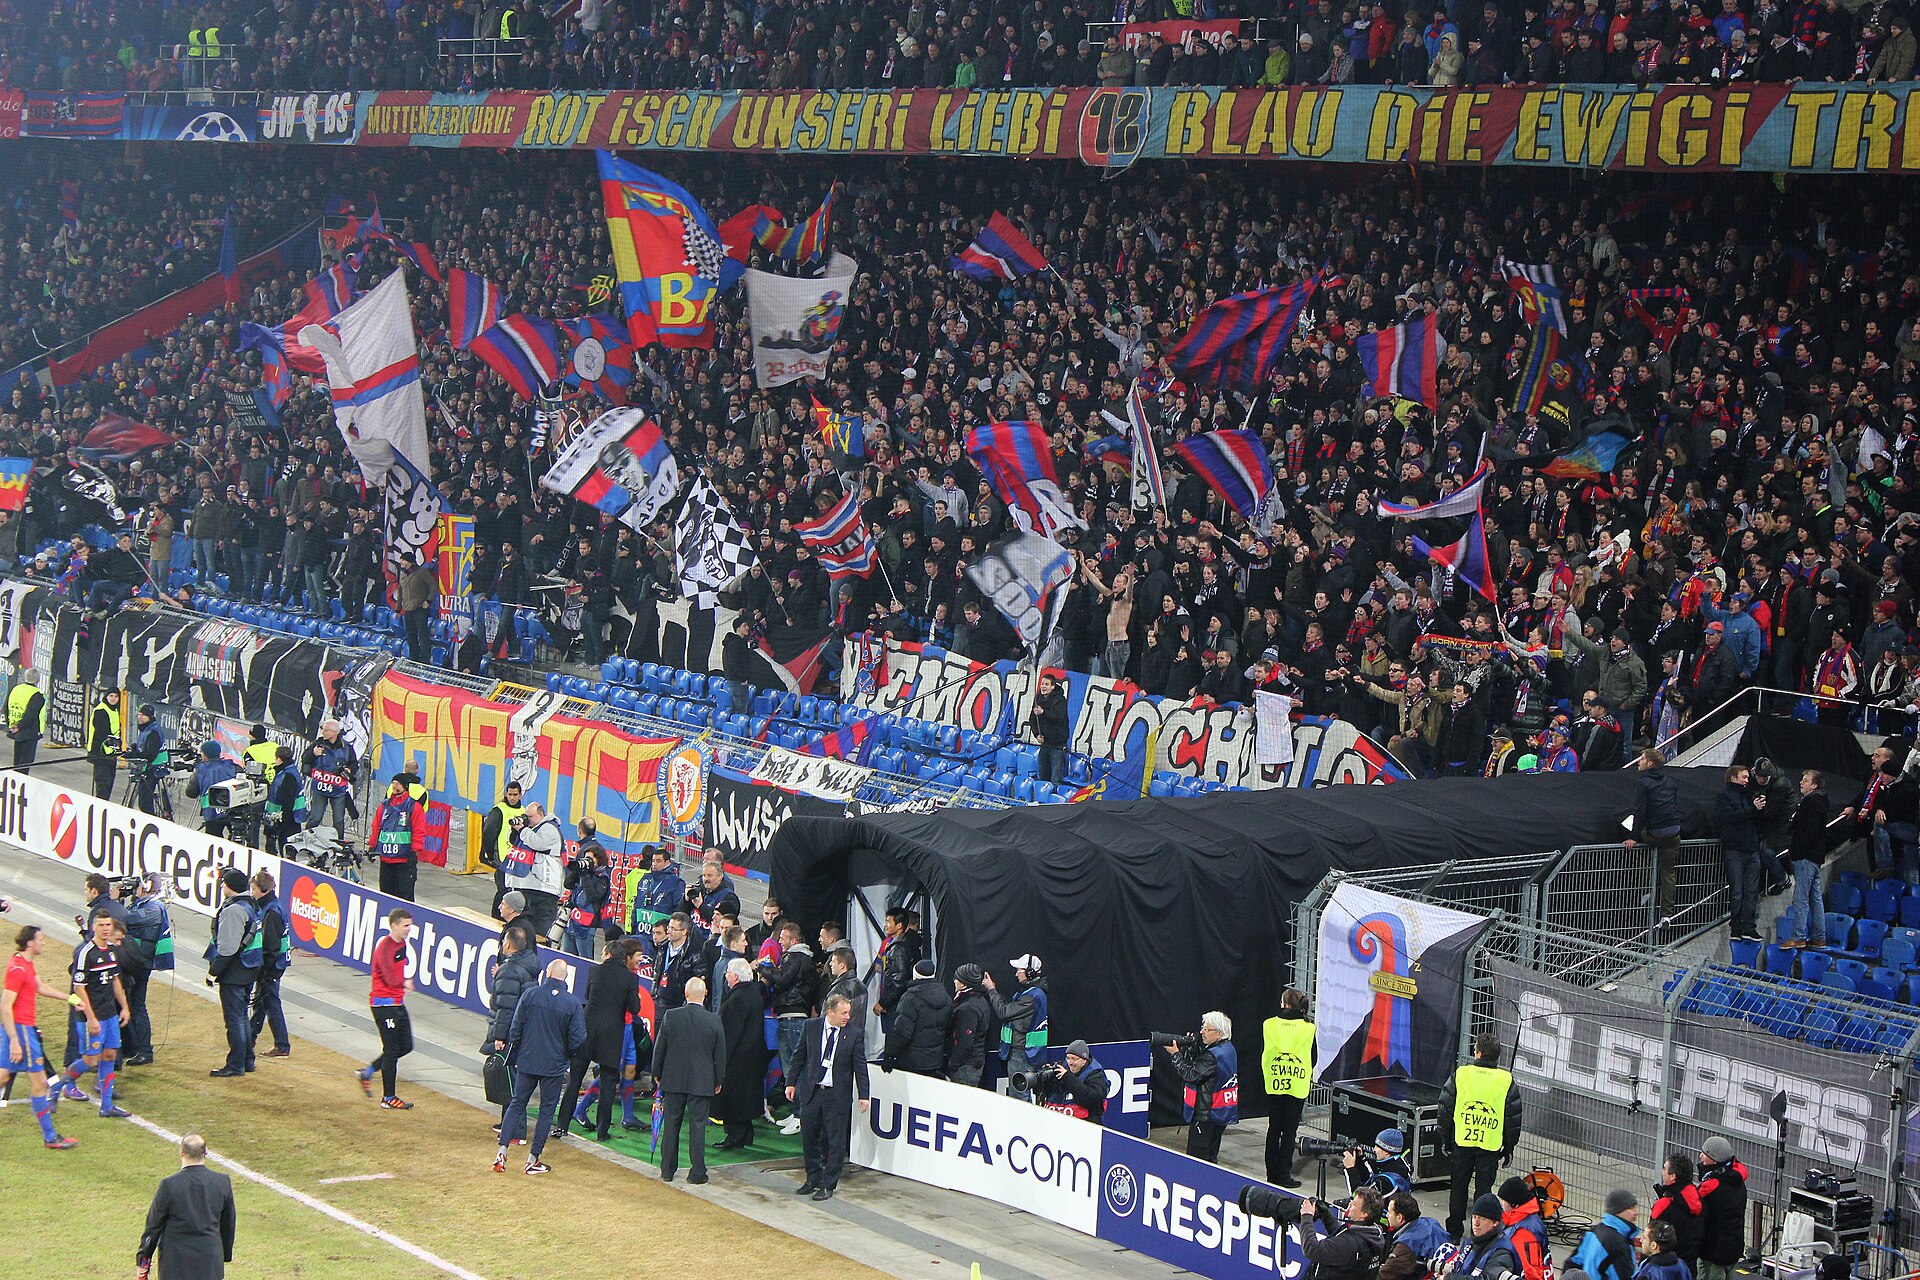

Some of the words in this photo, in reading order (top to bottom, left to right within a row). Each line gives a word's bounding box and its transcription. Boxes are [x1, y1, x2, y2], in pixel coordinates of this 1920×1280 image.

[366, 103, 515, 137] MUTTENZERKURVE
[522, 94, 606, 146] ROT
[1166, 88, 1342, 158] BLAU
[439, 594, 472, 613] ULTRA
[313, 770, 342, 784] PHOTO
[317, 782, 333, 793] 034
[382, 844, 399, 854] 018
[289, 897, 339, 929] MasterCard
[641, 911, 653, 921] TV
[1376, 977, 1396, 989] SINCE
[1396, 980, 1411, 992] 2001
[385, 1018, 396, 1029] 14
[1272, 1078, 1292, 1091] 053
[1513, 990, 1873, 1164] SLEEPERS
[1463, 1128, 1485, 1143] 251
[1110, 1167, 1131, 1184] UEFA
[1142, 1172, 1302, 1279] RESPEC
